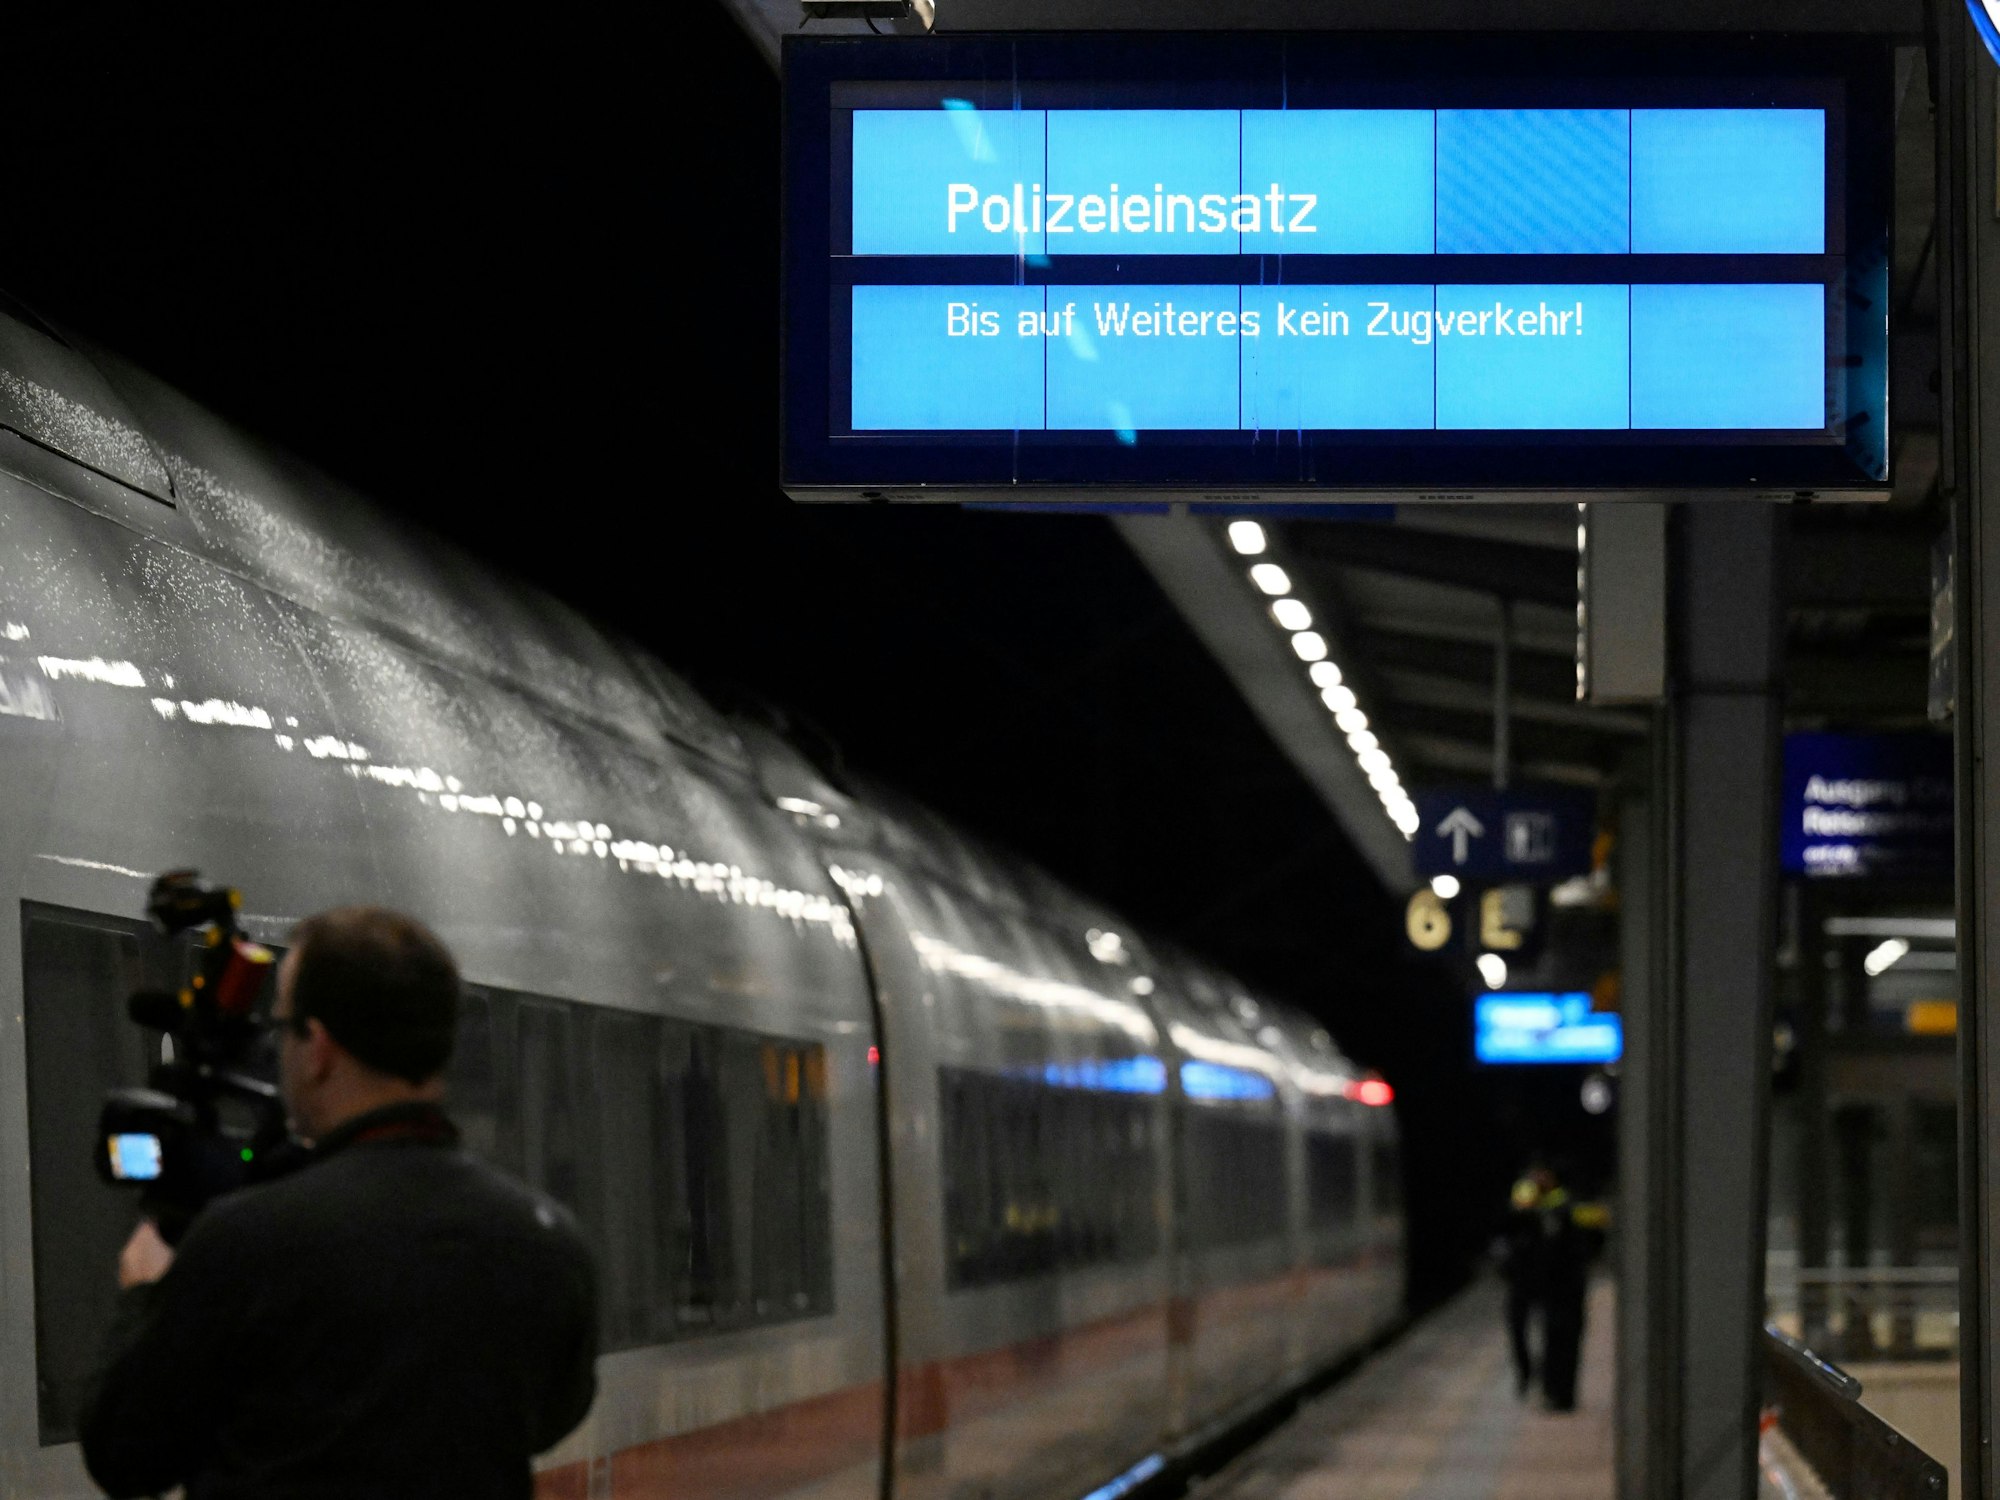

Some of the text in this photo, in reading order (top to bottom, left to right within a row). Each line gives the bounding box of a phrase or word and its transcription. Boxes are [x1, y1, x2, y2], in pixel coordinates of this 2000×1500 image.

[945, 182, 1318, 235] Polizeieinsatz
[946, 301, 1584, 345] Bis auf Weiteres kein Zugverkehr!
[1405, 887, 1453, 951] 6
